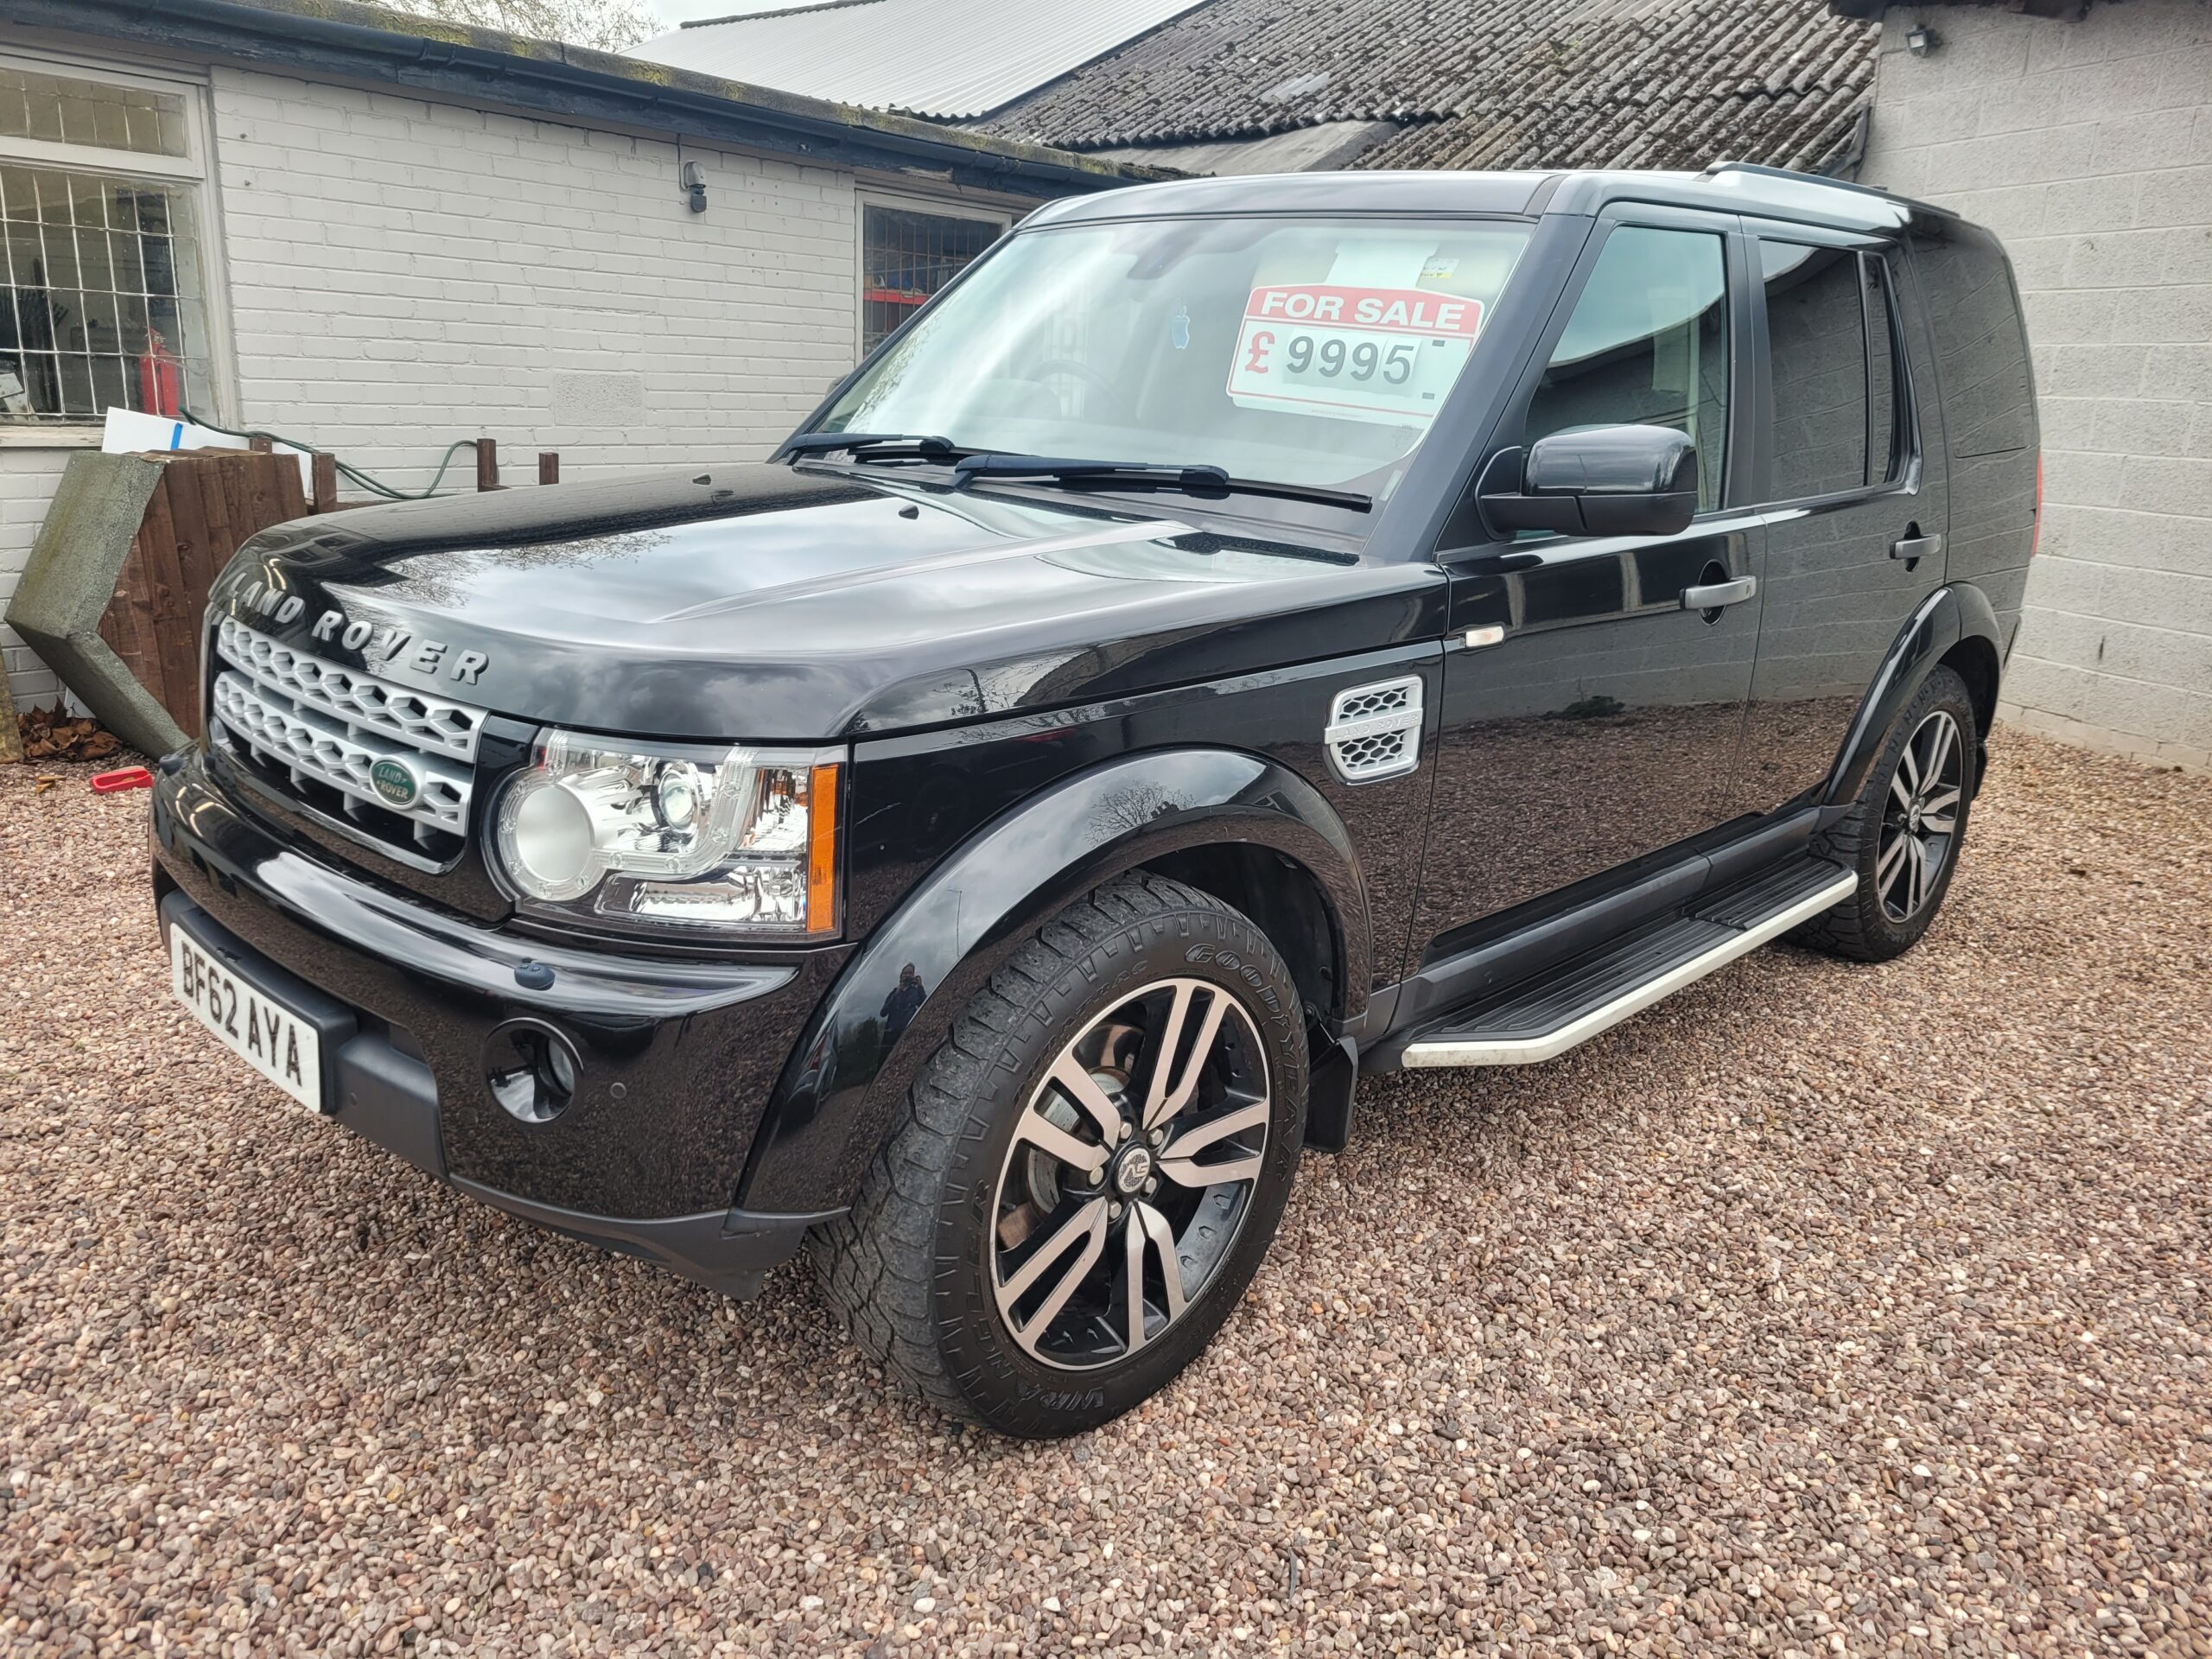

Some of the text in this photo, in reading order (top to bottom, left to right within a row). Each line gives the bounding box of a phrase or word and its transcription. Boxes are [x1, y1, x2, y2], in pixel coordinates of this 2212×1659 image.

[1261, 291, 1465, 330] FOR SALE
[1244, 331, 1414, 385] £ 9995
[230, 572, 489, 686] LAND ROVER
[378, 766, 402, 783] LAND
[380, 780, 408, 799] ROVER
[181, 940, 302, 1087] BF62 AYA
[1185, 943, 1300, 1183] GOODYEAR
